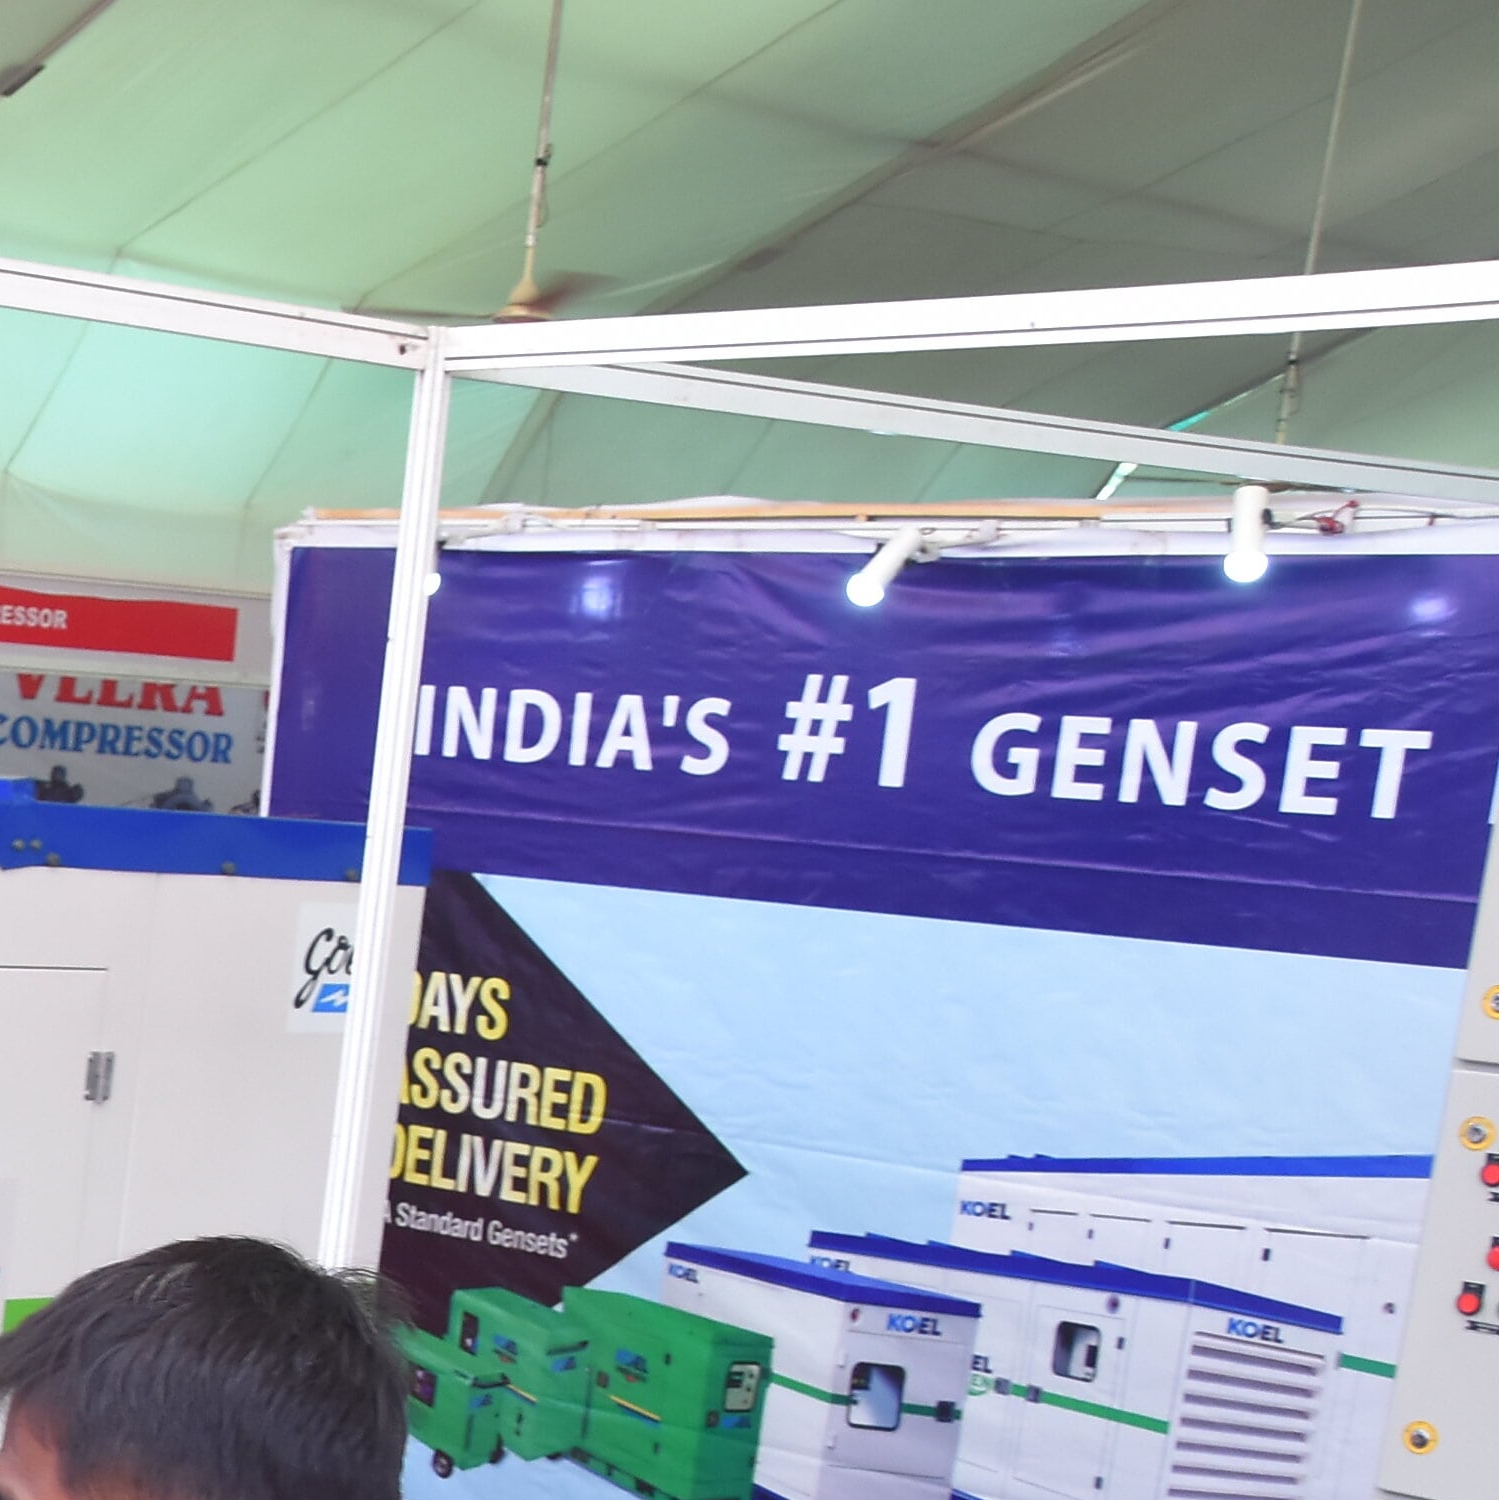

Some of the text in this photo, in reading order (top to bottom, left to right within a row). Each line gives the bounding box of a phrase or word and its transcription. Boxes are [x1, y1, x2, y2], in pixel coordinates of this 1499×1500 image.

[412, 674, 1432, 820] INDIA'S #1 GENSET
[397, 1202, 483, 1241] Standard
[960, 1200, 1011, 1220] KOEL
[669, 1264, 698, 1284] KOEL
[887, 1313, 941, 1337] KOEL
[1227, 1317, 1283, 1343] KOEL
